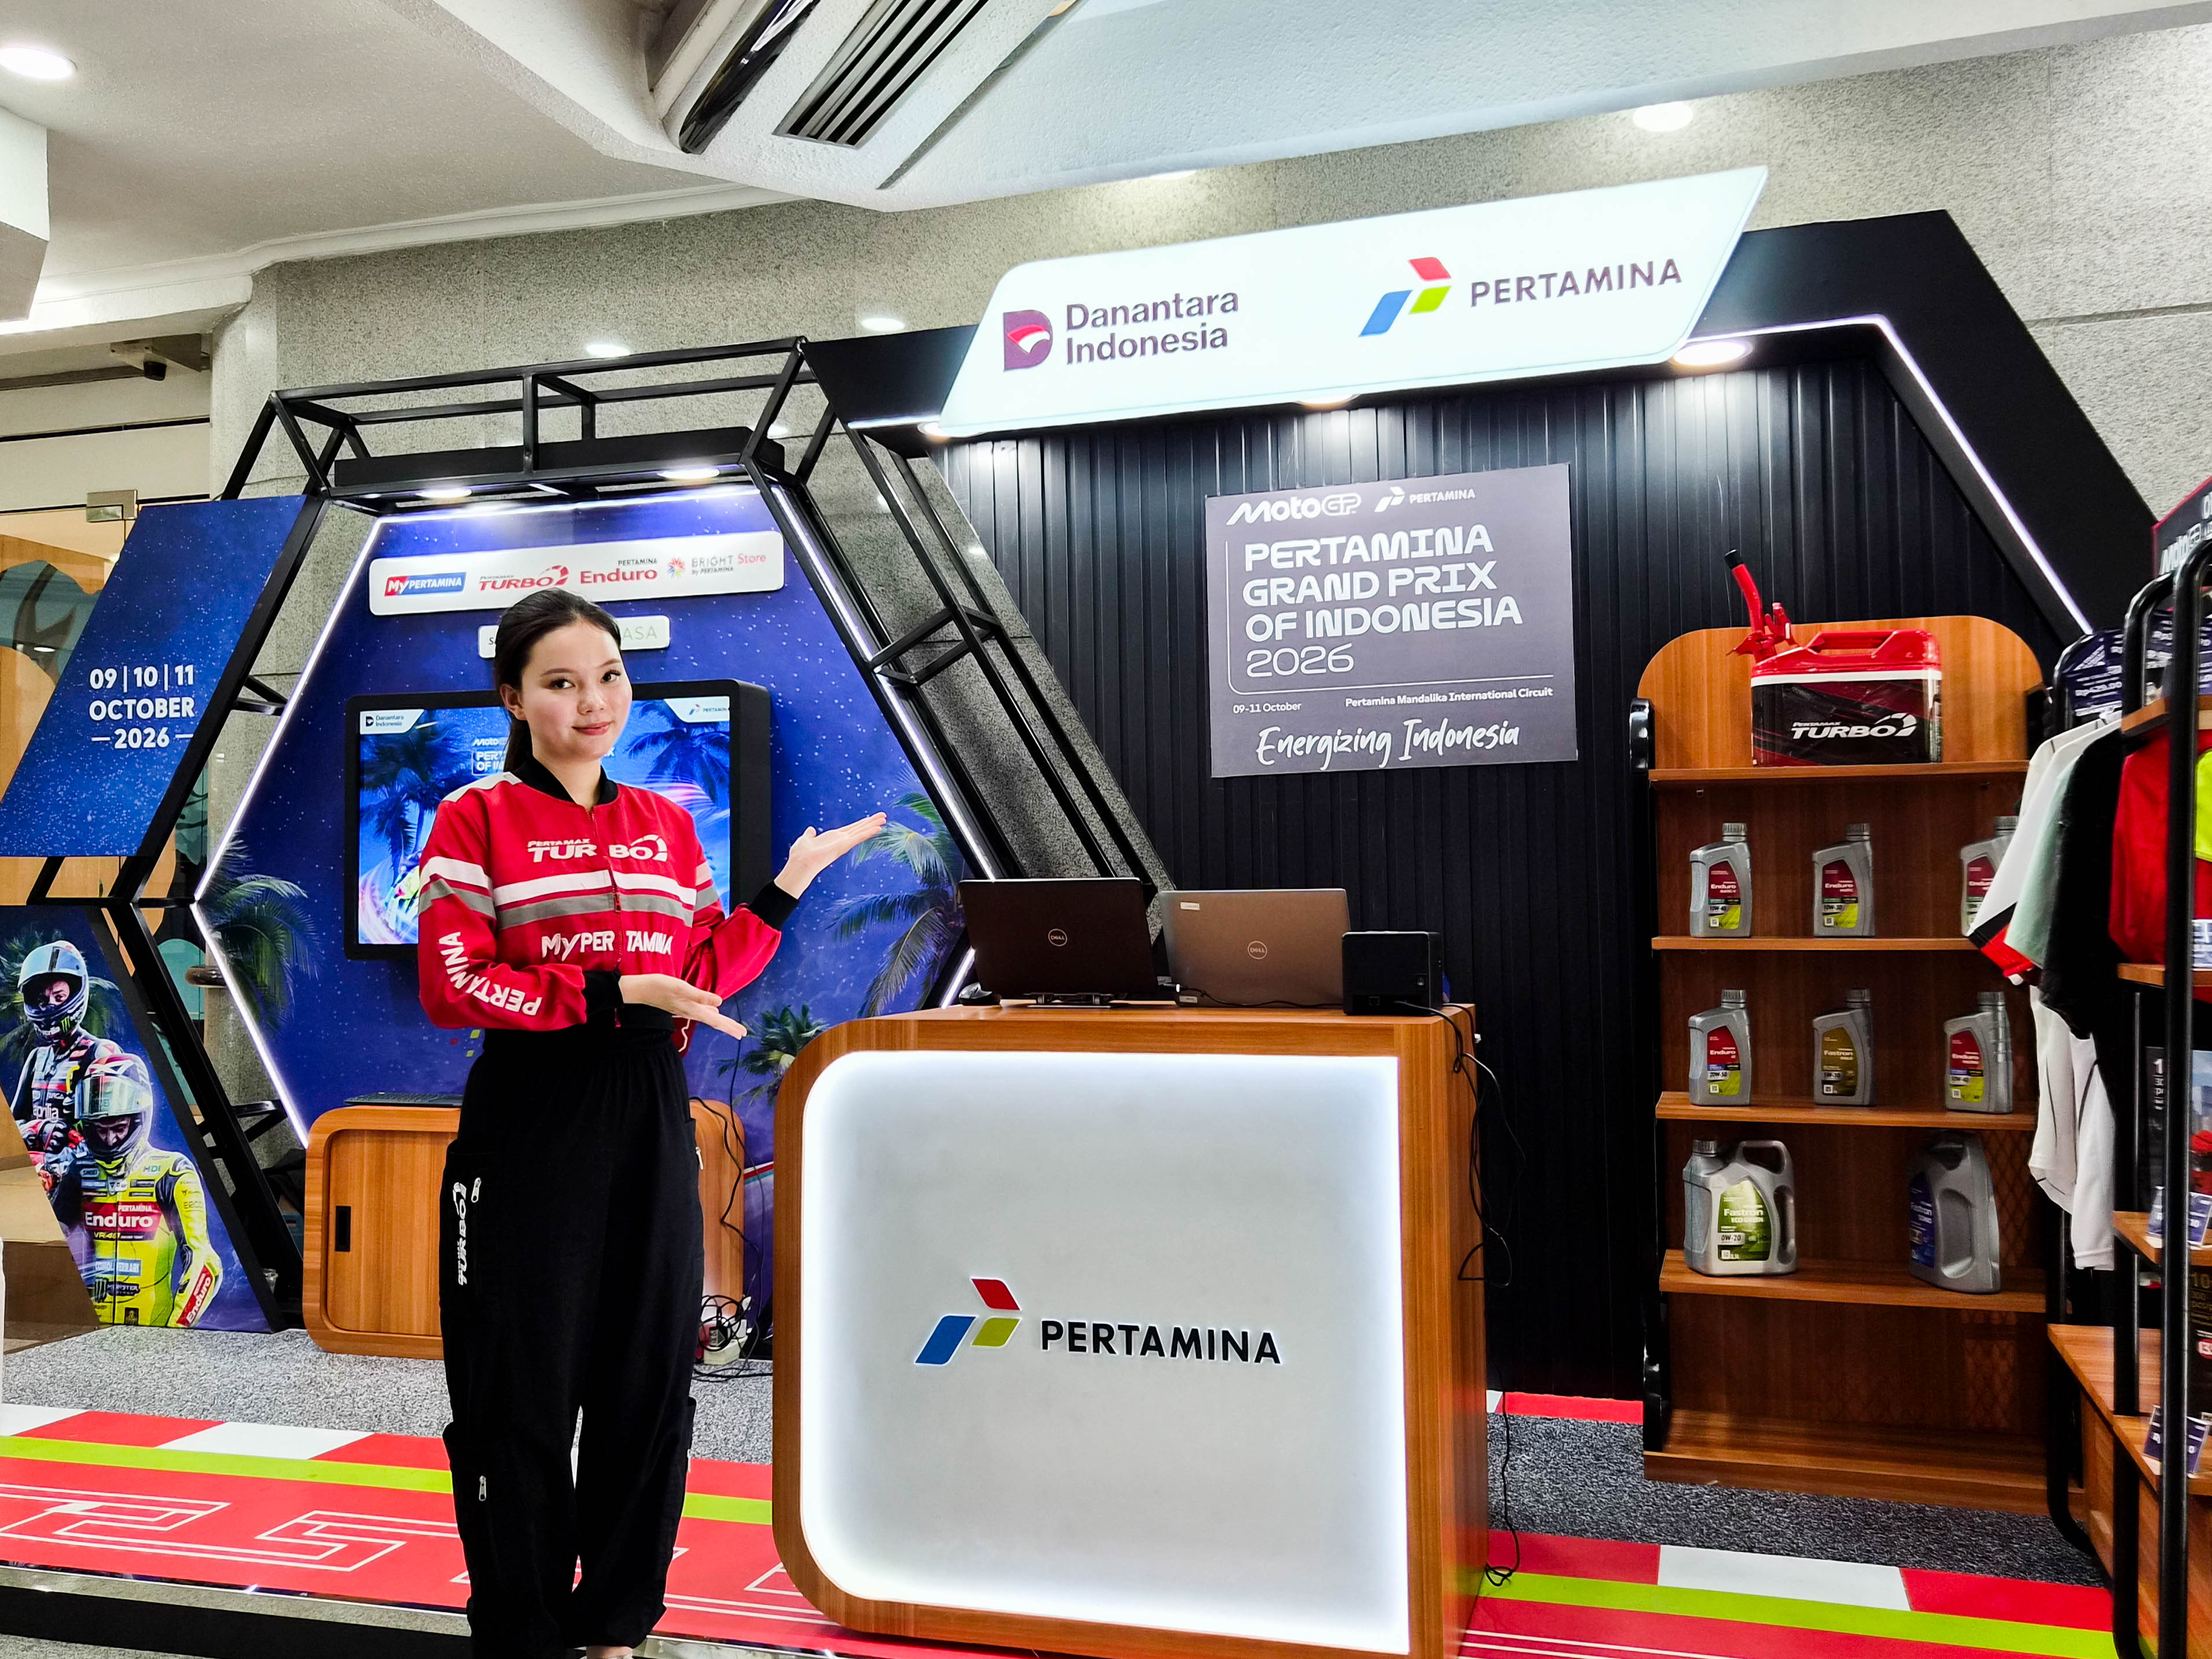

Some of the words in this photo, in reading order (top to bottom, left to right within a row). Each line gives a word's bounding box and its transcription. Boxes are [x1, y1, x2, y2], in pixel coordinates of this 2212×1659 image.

[1471, 258, 1682, 308] PERTAMINA
[1065, 291, 1239, 332] Danantara
[1066, 323, 1228, 366] Indonesia
[1409, 488, 1475, 504] PERTAMINA
[1226, 492, 1361, 525] MotoGP
[1244, 524, 1493, 572] PERTAMINA
[618, 558, 657, 567] PERTAMINA
[692, 555, 733, 568] BRIGHT
[737, 553, 766, 565] Store
[479, 576, 554, 591] TURBO
[580, 568, 657, 584] Enduro
[1242, 572, 1380, 606] GRAND
[1388, 561, 1497, 597] PRIX
[1245, 611, 1296, 642] OF
[1305, 596, 1523, 639] INDONESIA
[1246, 643, 1354, 678] 2026
[89, 668, 116, 689] 09
[134, 667, 157, 687] 10
[175, 665, 194, 685] 11
[89, 697, 194, 720] OCTOBER
[1233, 703, 1261, 713] 09-11
[1262, 701, 1302, 712] October
[1346, 697, 1395, 707] Pertamina
[1397, 693, 1447, 704] Mandalika
[1449, 690, 1516, 701] International
[1518, 687, 1553, 698] Circuit
[115, 727, 170, 749] 2026
[1791, 724, 1897, 740] TURBO
[1255, 726, 1391, 770] Energizing
[1398, 719, 1519, 762] Indonesia
[527, 838, 590, 847] PERTAMAX
[85, 1212, 153, 1228] Enduro
[1724, 1208, 1763, 1216] Fastron
[185, 1277, 211, 1324] Enduro
[1042, 1320, 1281, 1364] PERTAMINA
